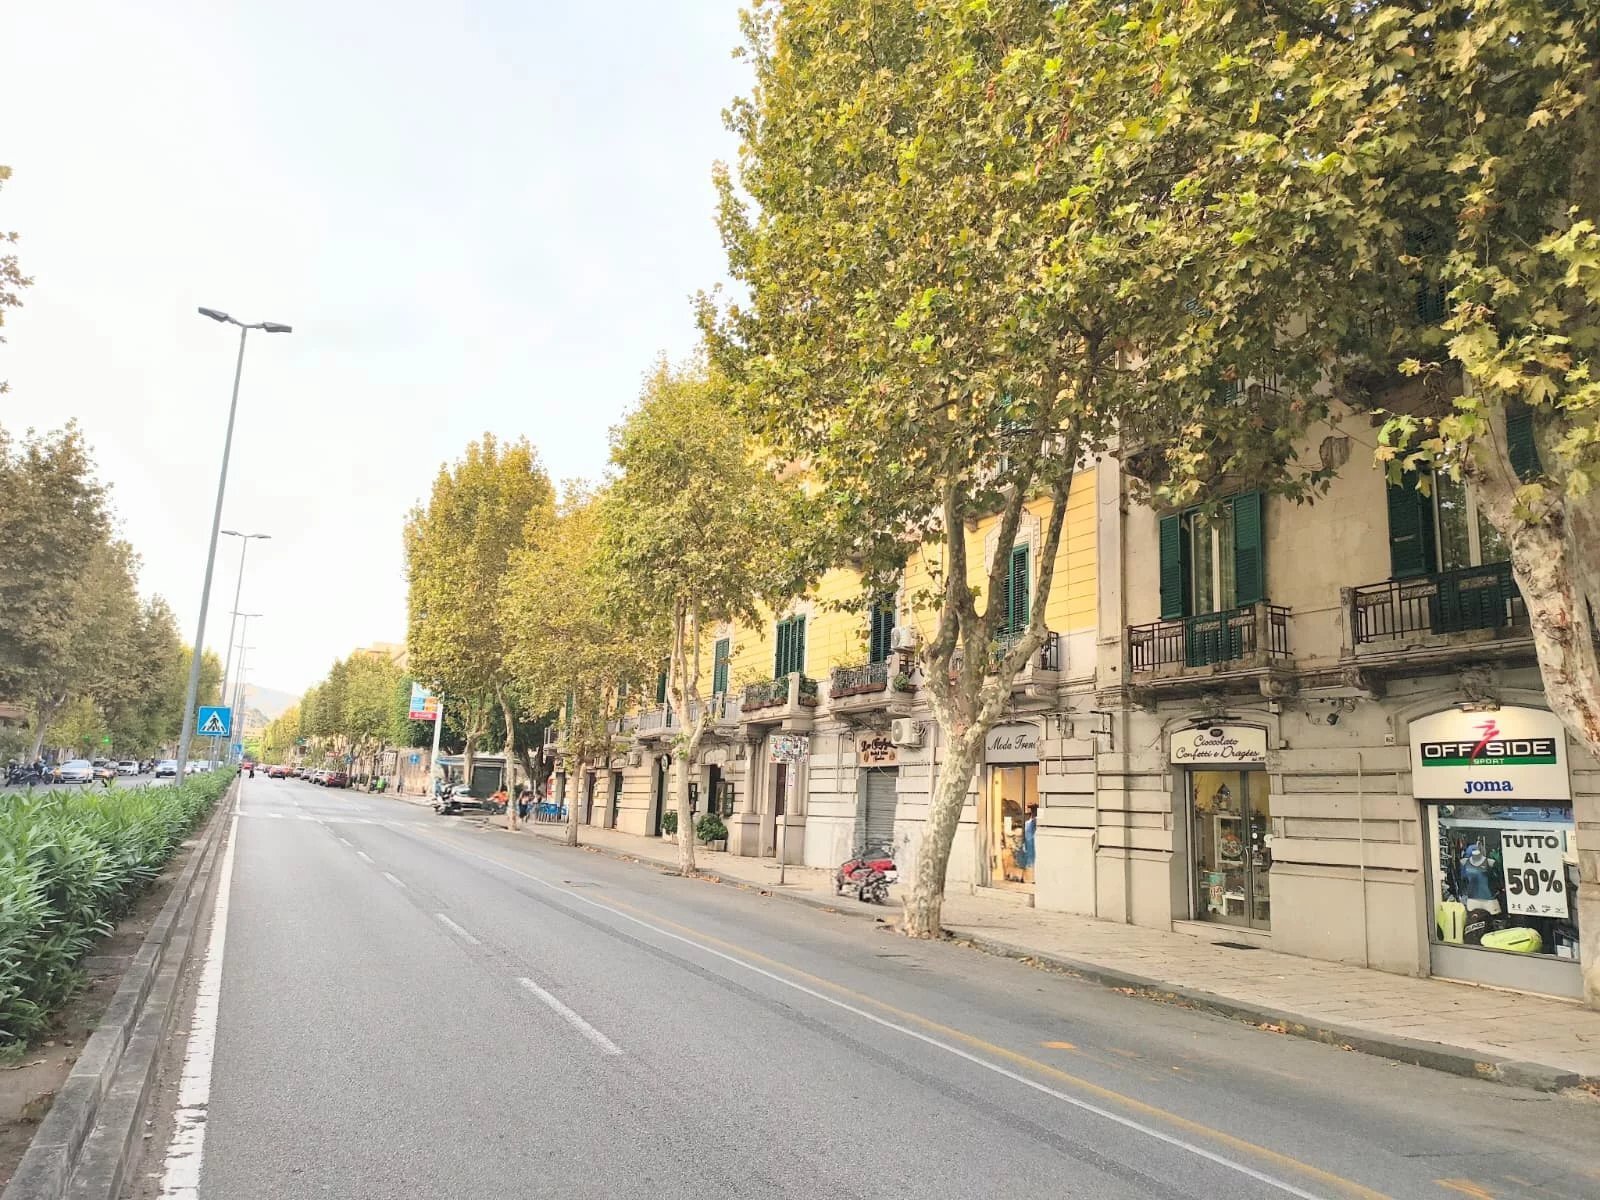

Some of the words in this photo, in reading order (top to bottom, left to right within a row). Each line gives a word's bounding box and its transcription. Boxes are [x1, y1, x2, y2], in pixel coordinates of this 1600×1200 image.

[987, 735, 1012, 751] Moda
[1424, 743, 1475, 758] OFF
[1485, 741, 1552, 756] SIDE
[1175, 746, 1213, 760] Confetti
[1502, 834, 1560, 849] TUTTO
[1523, 852, 1542, 864] AL
[1507, 867, 1563, 896] 50%
